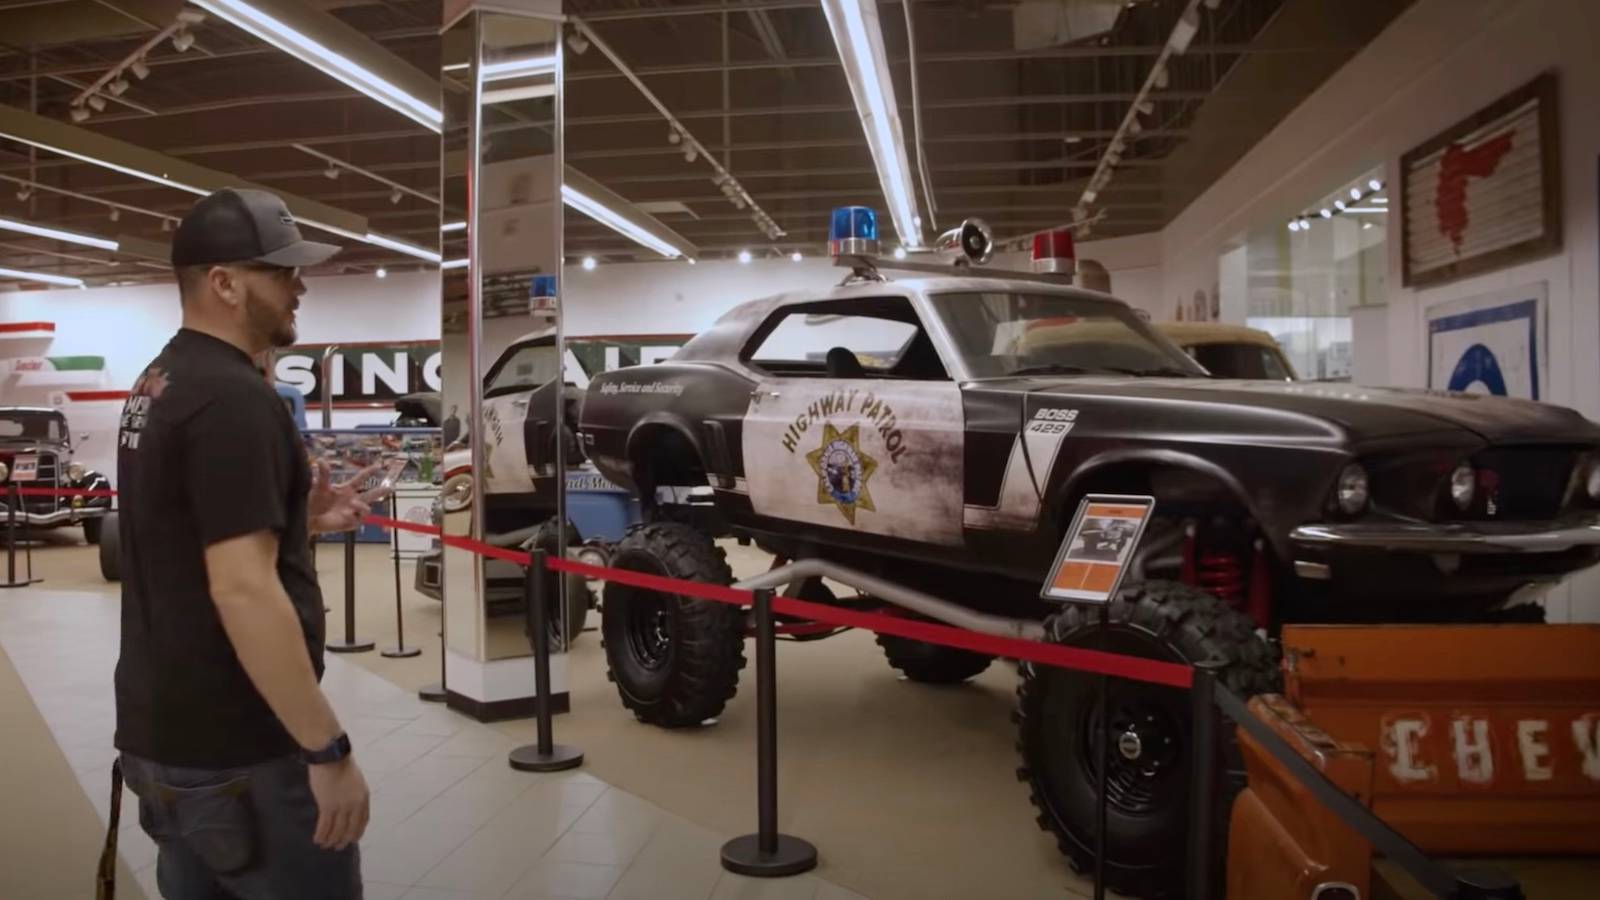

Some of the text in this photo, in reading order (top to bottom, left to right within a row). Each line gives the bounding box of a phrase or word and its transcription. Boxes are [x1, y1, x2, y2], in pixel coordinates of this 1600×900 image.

[641, 382, 656, 393] and
[656, 382, 684, 397] Security
[1034, 408, 1079, 421] BOSS
[782, 389, 907, 464] HIGHWAY PATROL
[1031, 423, 1066, 434] 429
